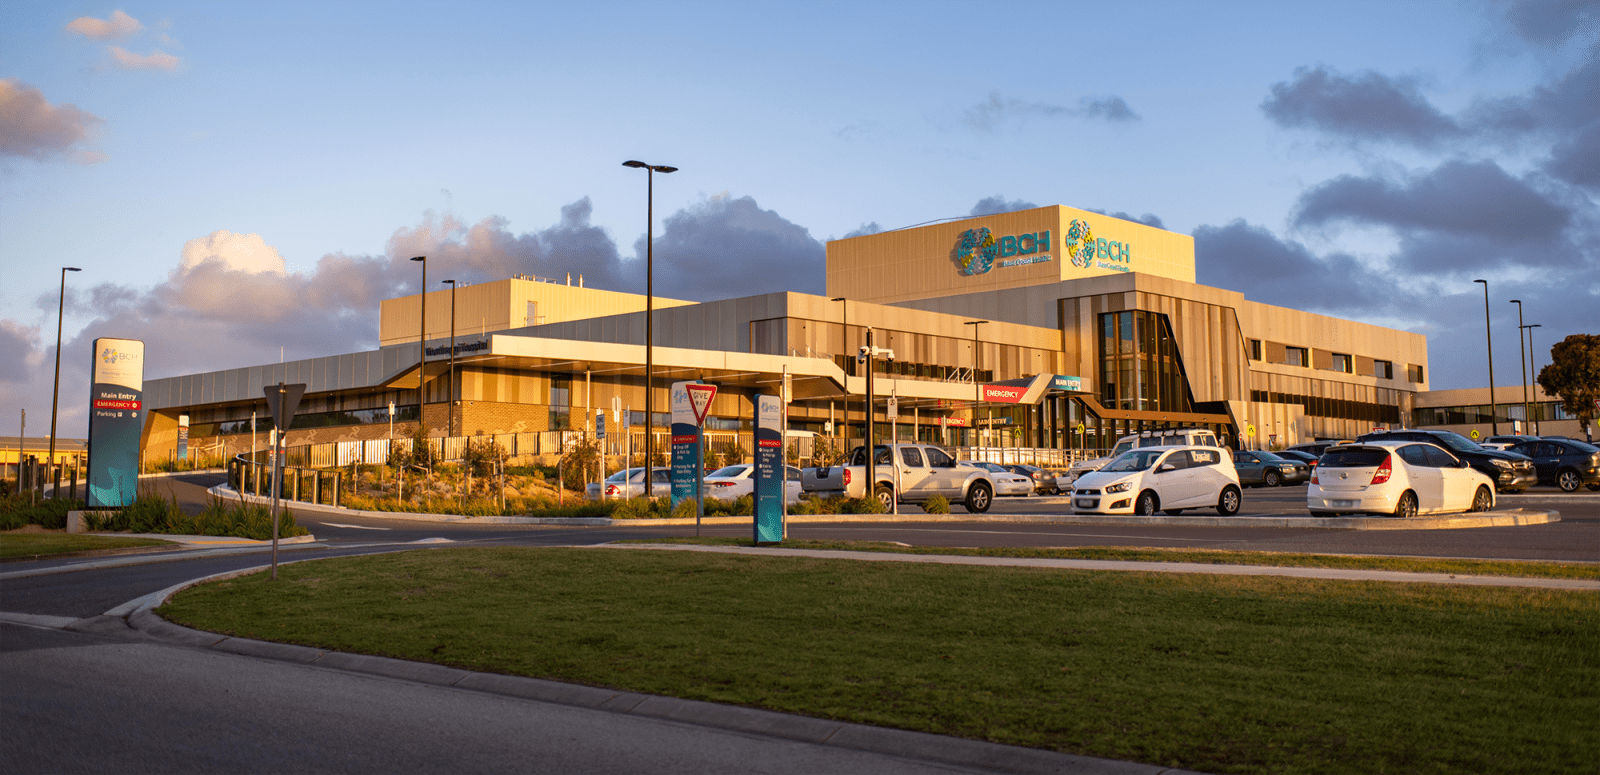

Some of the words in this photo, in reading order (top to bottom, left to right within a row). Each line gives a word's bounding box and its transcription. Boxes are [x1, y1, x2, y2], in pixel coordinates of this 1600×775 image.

[1001, 230, 1050, 257] BCH
[1097, 237, 1130, 263] BCH
[119, 352, 137, 360] BCH
[118, 392, 136, 401] Entry
[986, 390, 1018, 398] EMERGENCY
